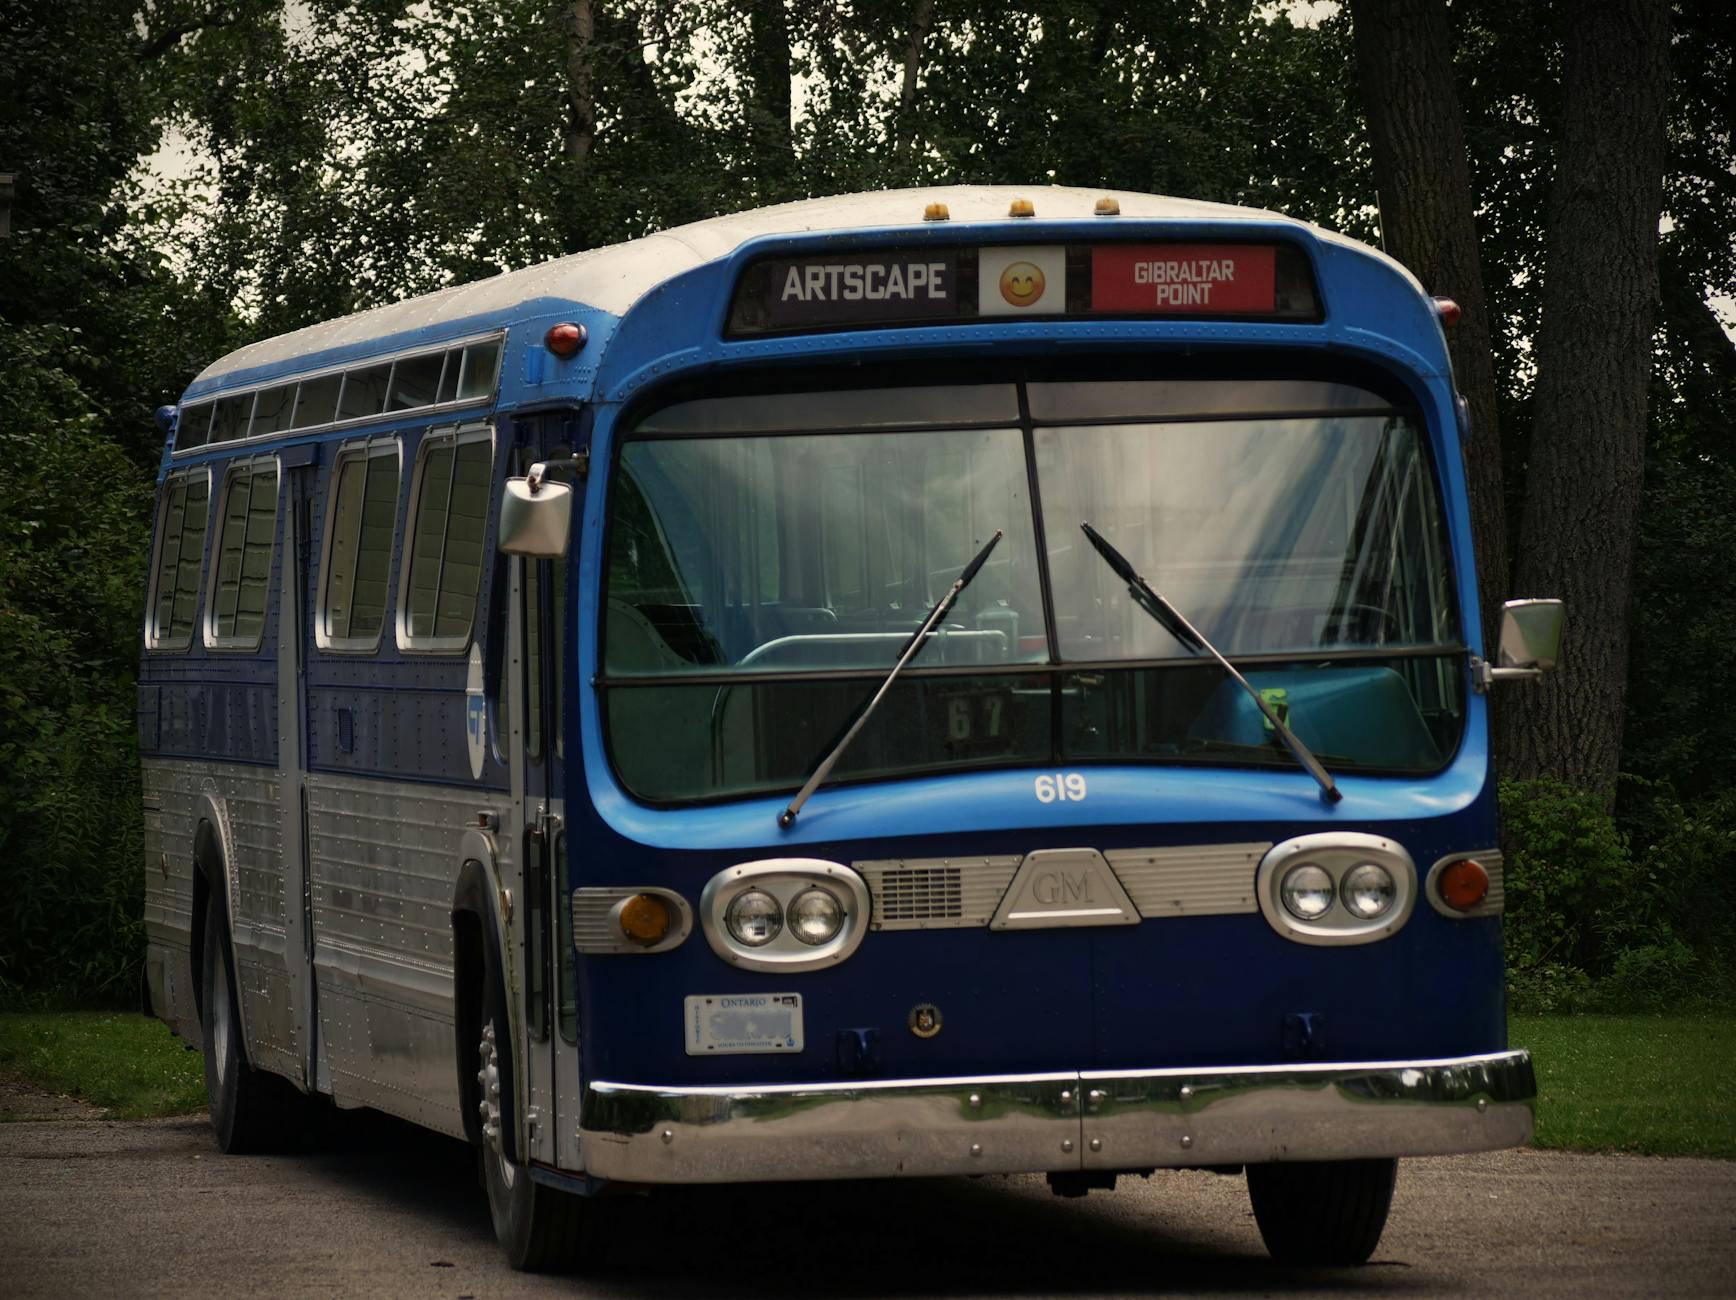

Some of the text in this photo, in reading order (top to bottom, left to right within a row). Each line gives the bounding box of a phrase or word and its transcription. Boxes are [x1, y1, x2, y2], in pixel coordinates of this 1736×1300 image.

[780, 262, 948, 302] ARTSCAPE
[1133, 259, 1235, 284] GIBRALTAR
[1155, 283, 1214, 306] POINT
[1034, 773, 1087, 804] 619
[1033, 871, 1095, 905] GM
